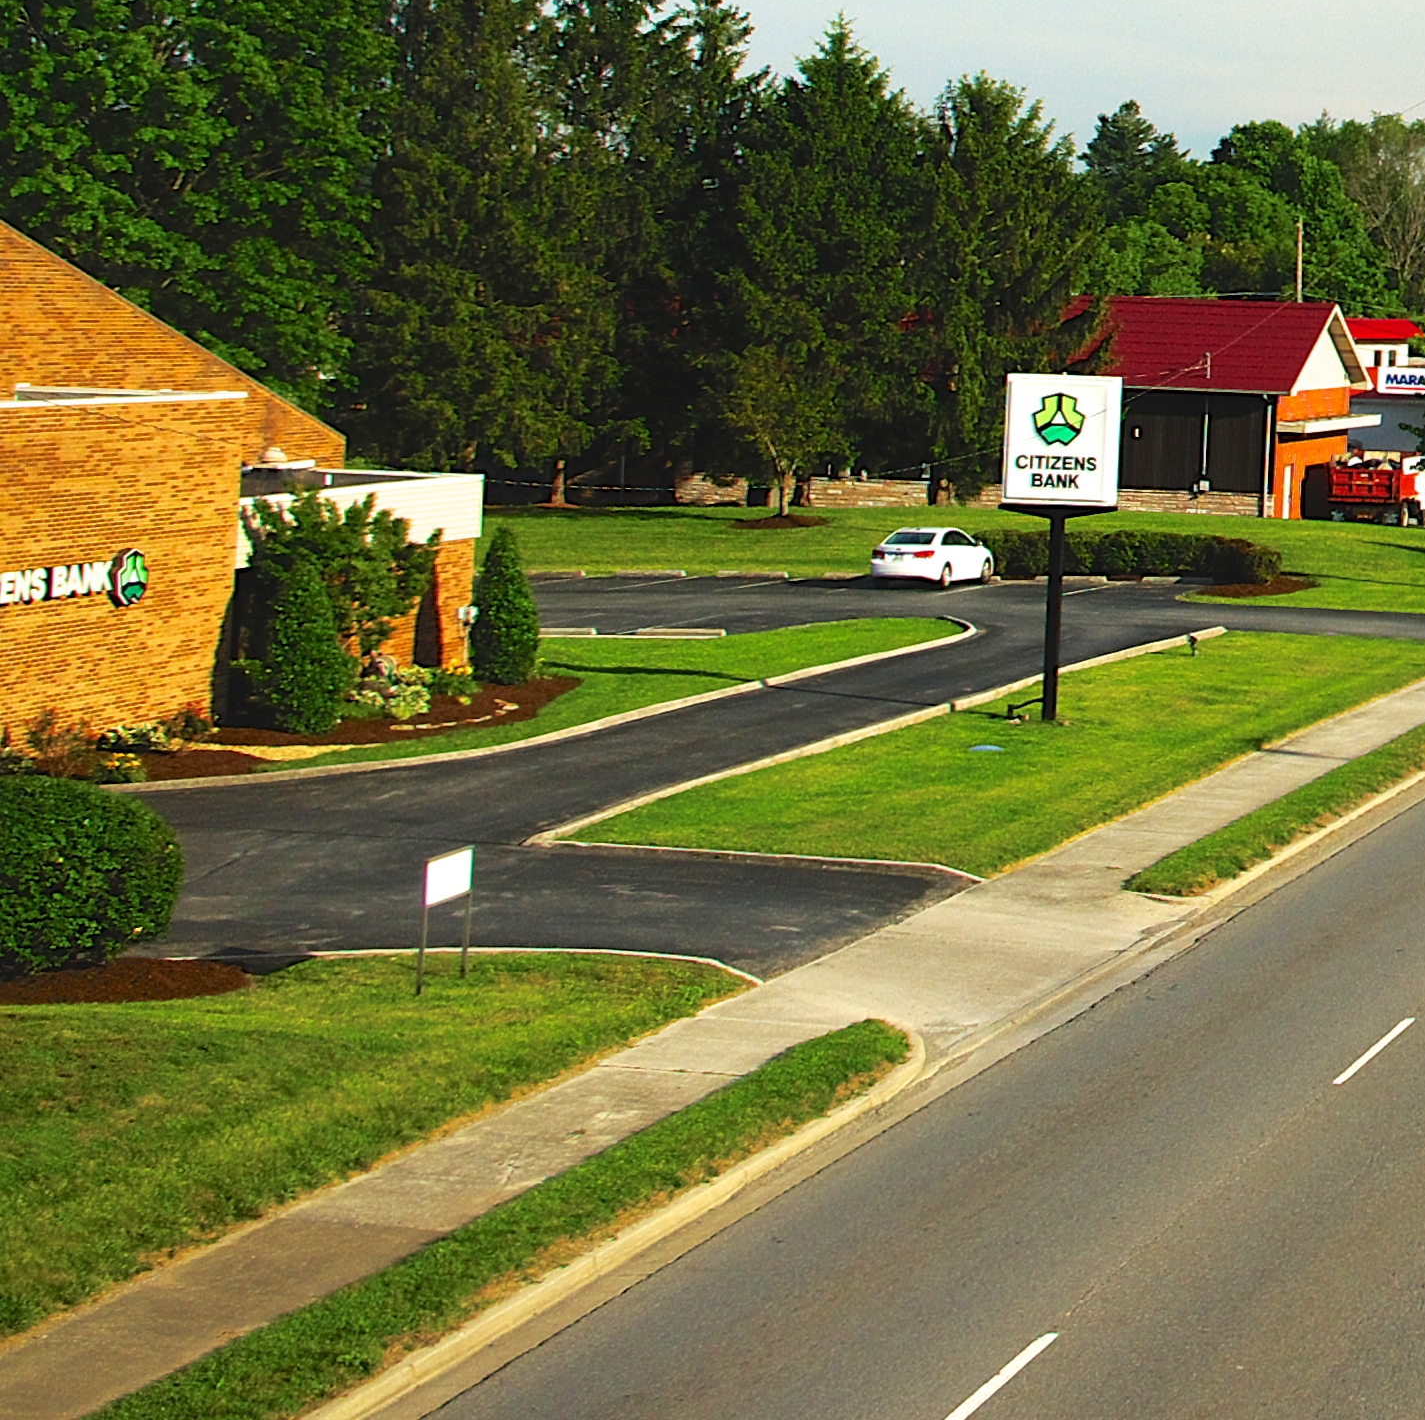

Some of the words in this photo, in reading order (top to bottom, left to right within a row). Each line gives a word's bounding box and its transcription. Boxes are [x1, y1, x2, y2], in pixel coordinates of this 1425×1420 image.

[1015, 455, 1098, 471] CITIZENS
[1031, 473, 1080, 489] BANK
[51, 561, 114, 598] BANK
